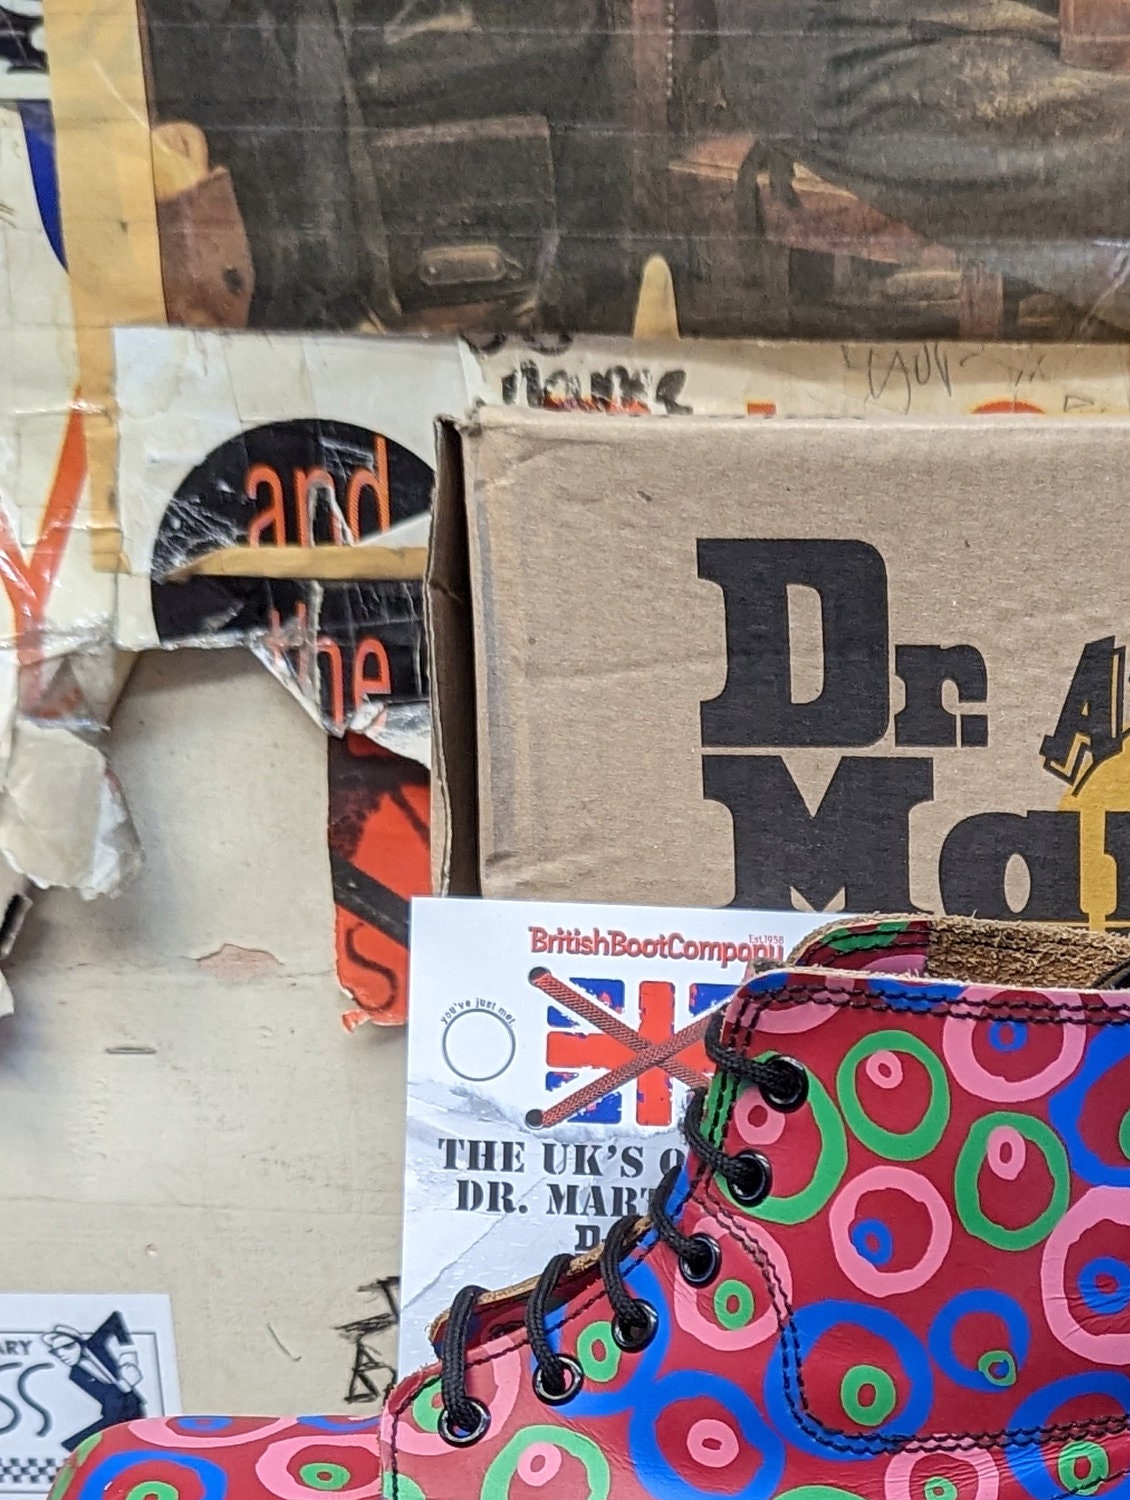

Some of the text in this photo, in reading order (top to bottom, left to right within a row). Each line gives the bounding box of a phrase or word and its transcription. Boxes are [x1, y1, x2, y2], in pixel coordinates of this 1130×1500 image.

[247, 433, 391, 548] and
[697, 538, 988, 747] Dr.
[475, 997, 496, 1010] just
[438, 1138, 525, 1172] THE
[543, 1143, 643, 1178] UK'S
[456, 1180, 656, 1217] DR. MART
